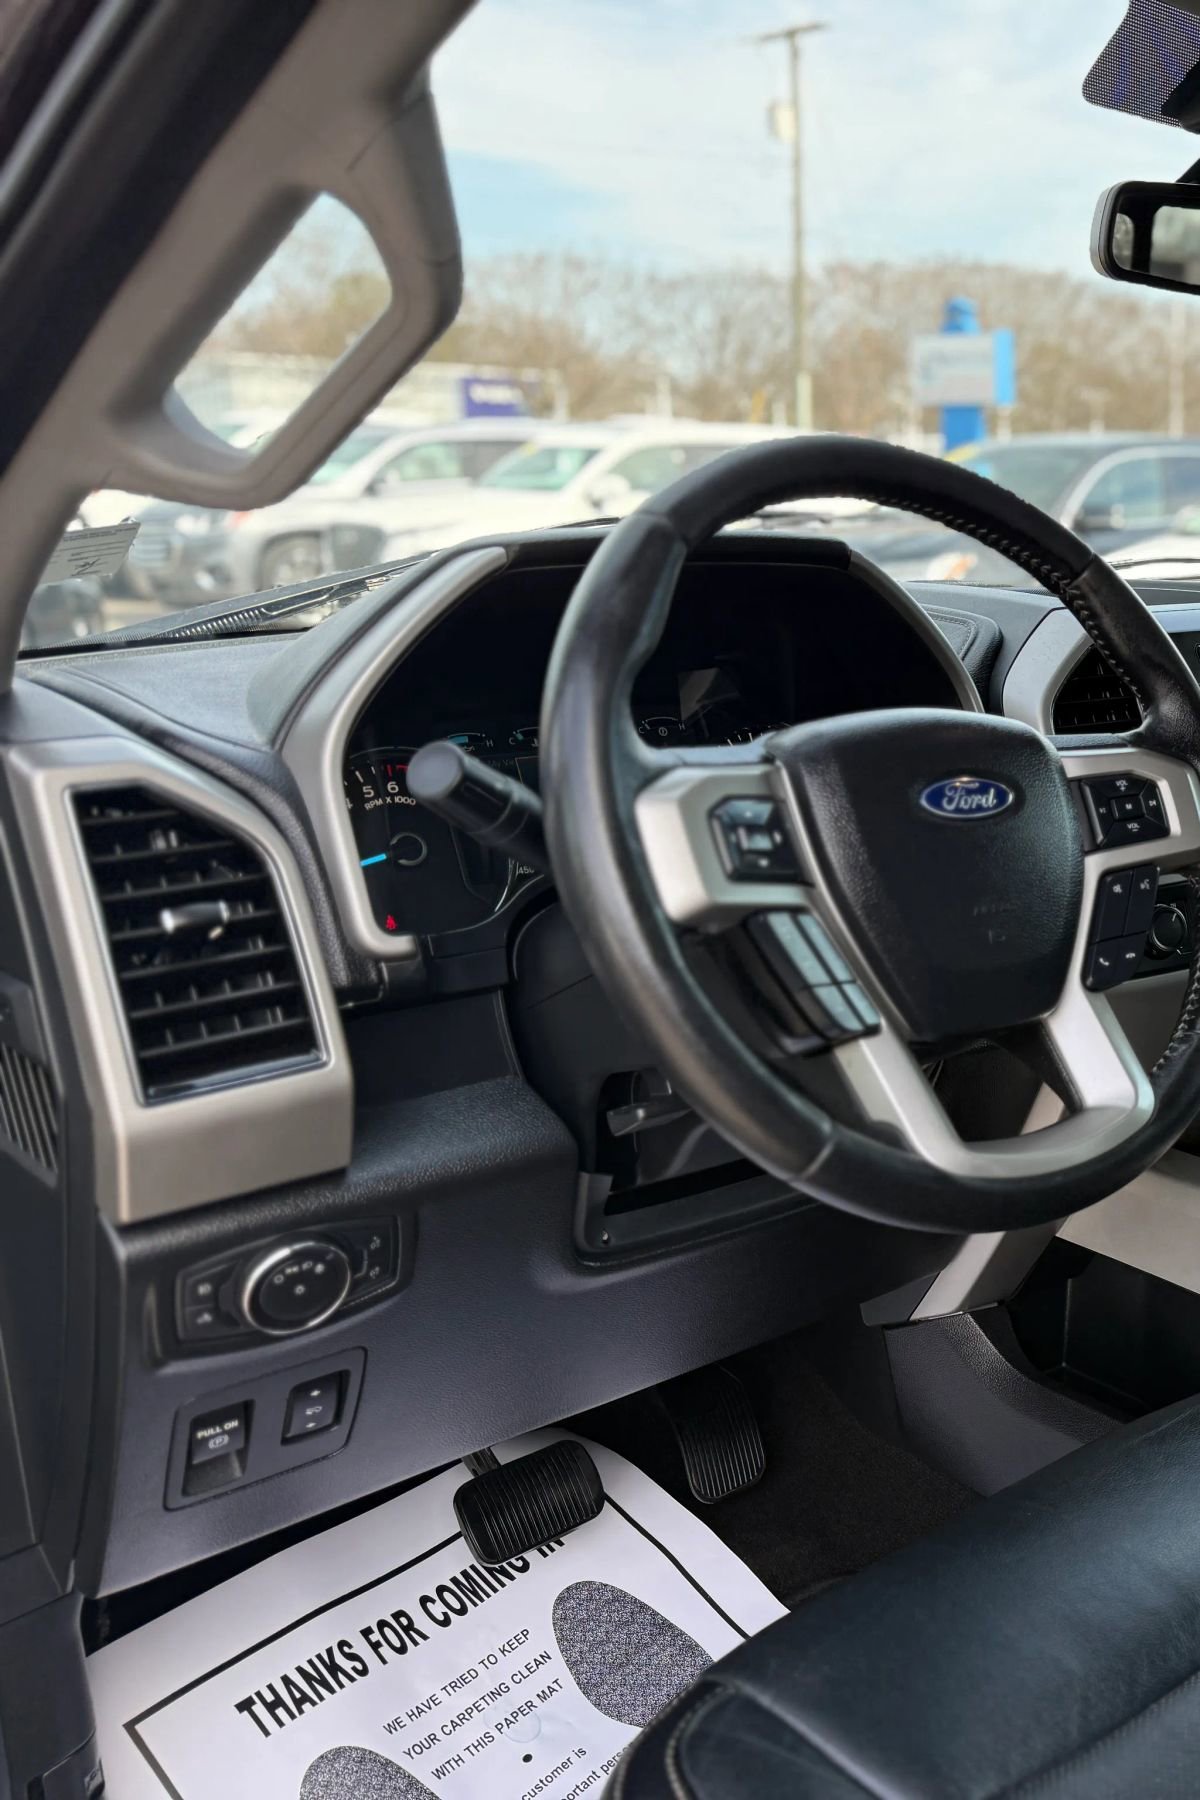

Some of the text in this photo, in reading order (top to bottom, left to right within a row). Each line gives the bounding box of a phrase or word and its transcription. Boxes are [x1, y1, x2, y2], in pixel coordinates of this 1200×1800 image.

[363, 781, 399, 797] 5 6
[943, 782, 997, 810] Ford
[1115, 779, 1129, 787] VOL
[364, 797, 383, 810] RPM
[394, 796, 416, 805] 1000
[1127, 822, 1140, 830] VOL
[197, 1420, 239, 1439] PULL ON
[234, 1639, 369, 1738] THANKS
[359, 1609, 430, 1665] FOR
[383, 1629, 530, 1735] WE HAVE TRIED TO KEEP
[402, 1650, 552, 1760] YOUR CARPETING CLEAN
[431, 1678, 563, 1780] WITH THIS PAPER MAT
[521, 1747, 587, 1800] customer is
[561, 1770, 601, 1800] ortant
